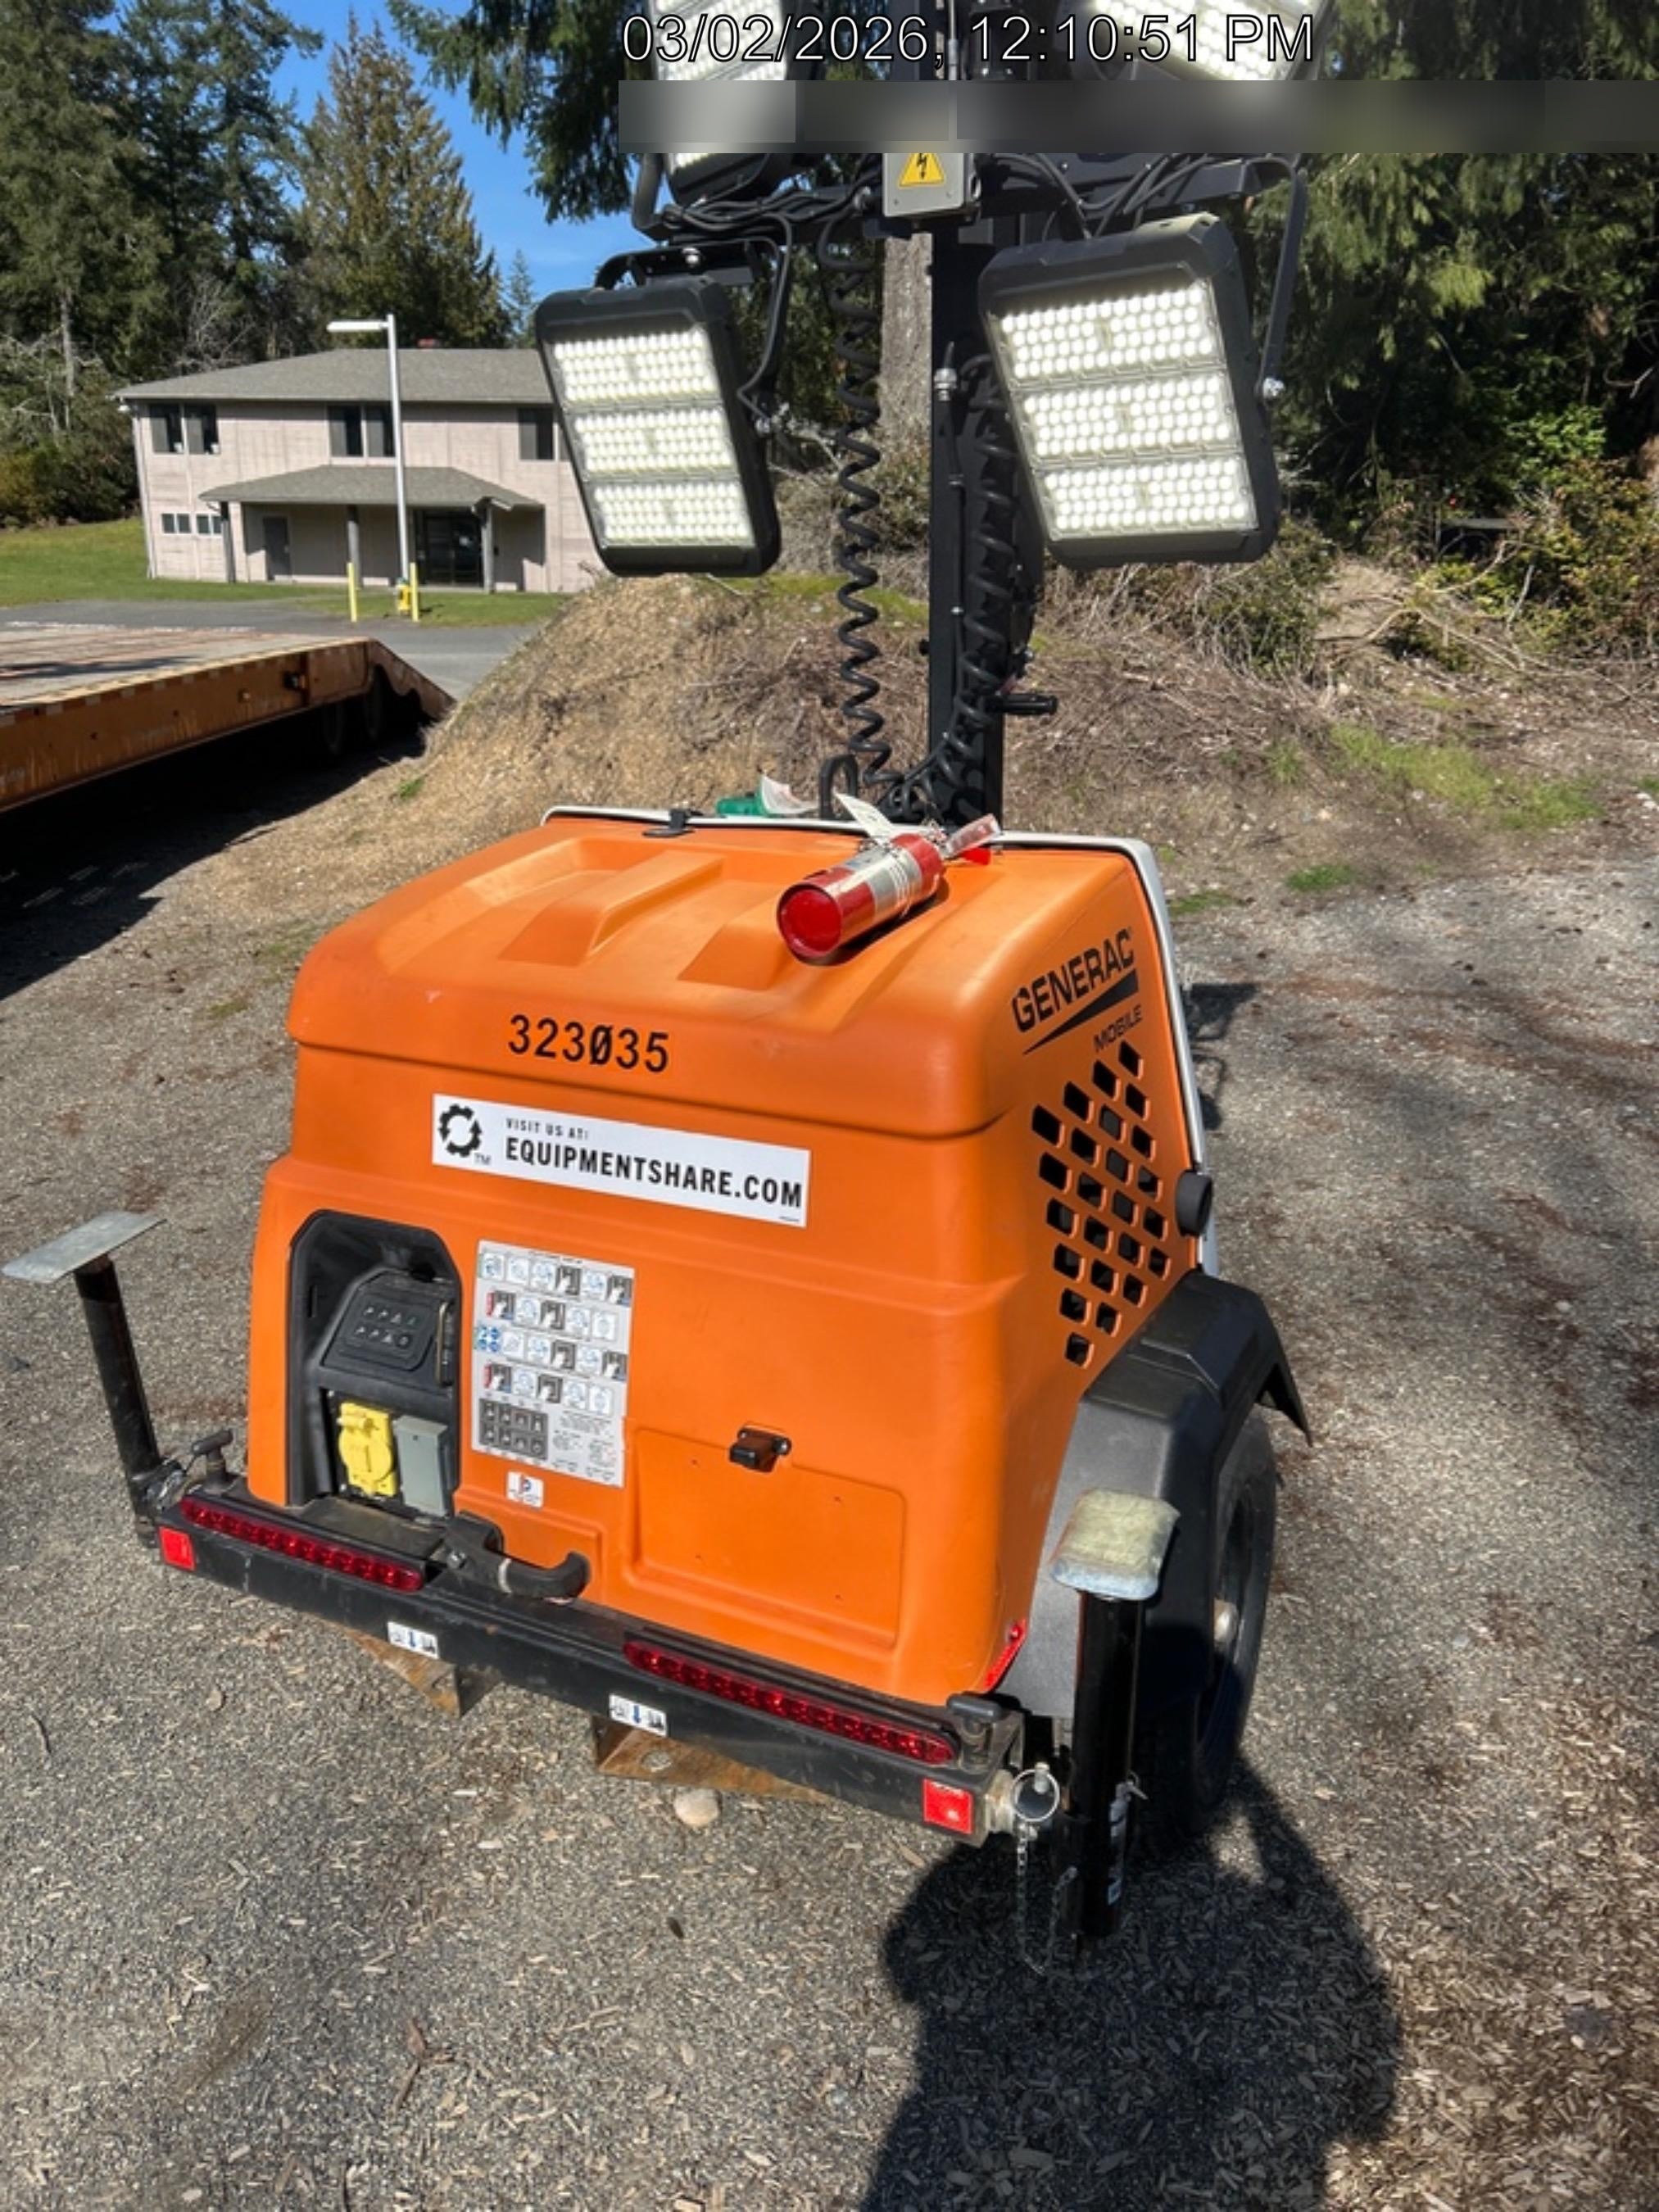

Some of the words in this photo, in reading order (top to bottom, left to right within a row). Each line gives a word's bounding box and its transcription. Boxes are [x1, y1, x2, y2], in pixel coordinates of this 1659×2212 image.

[1012, 927, 1135, 1033] GENERAC
[1093, 1004, 1143, 1053] MOBILE
[505, 1117, 541, 1134] VISIT
[546, 1123, 564, 1137] US
[474, 1152, 492, 1166] TM
[505, 1135, 803, 1208] EQUIPMENTSHARE.COM
